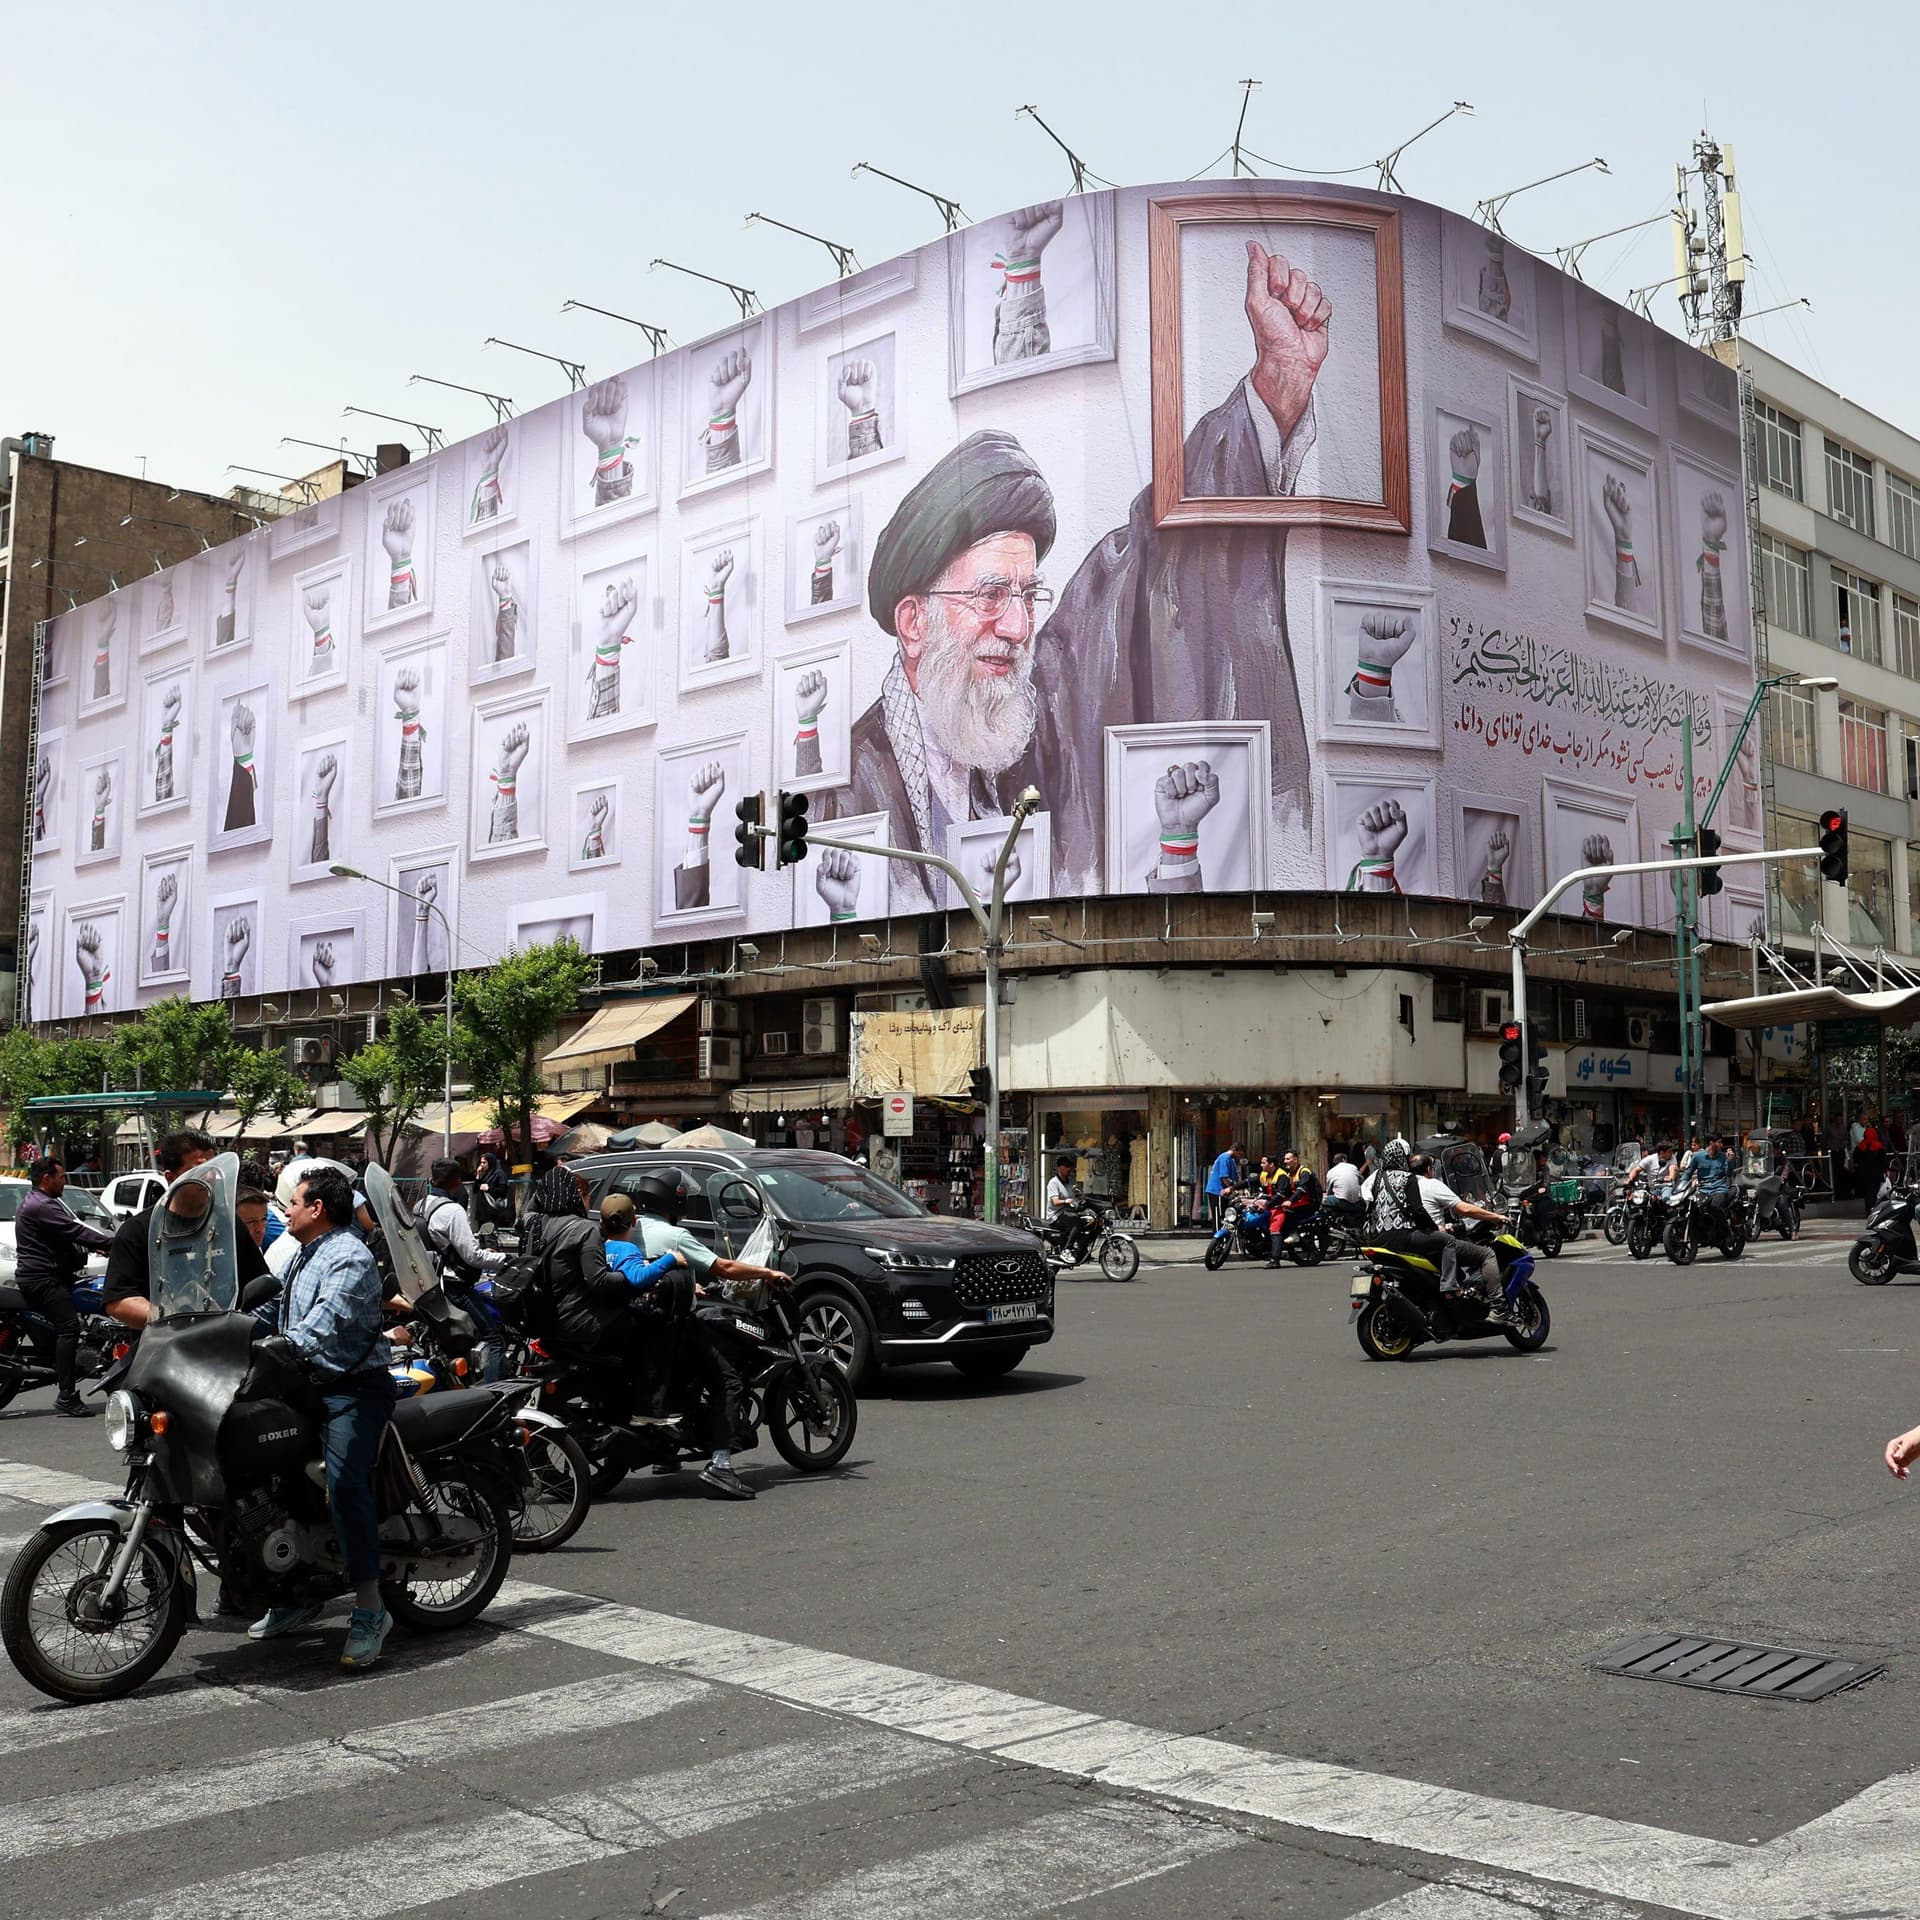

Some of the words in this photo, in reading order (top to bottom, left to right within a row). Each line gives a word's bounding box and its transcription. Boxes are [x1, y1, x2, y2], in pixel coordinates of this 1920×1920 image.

[1485, 711, 1524, 748] توانای
[1521, 719, 1552, 755] خدای
[1552, 729, 1584, 769] جانب
[1582, 735, 1593, 762] از
[1591, 727, 1612, 768] مگر
[1610, 739, 1631, 770] نشود
[1626, 735, 1654, 784] کسی
[1643, 752, 1674, 789] نصیب
[1576, 1052, 1595, 1081] نور
[1599, 1052, 1632, 1082] کوه
[736, 1319, 765, 1337] Benelli
[258, 1427, 298, 1443] BOXER
